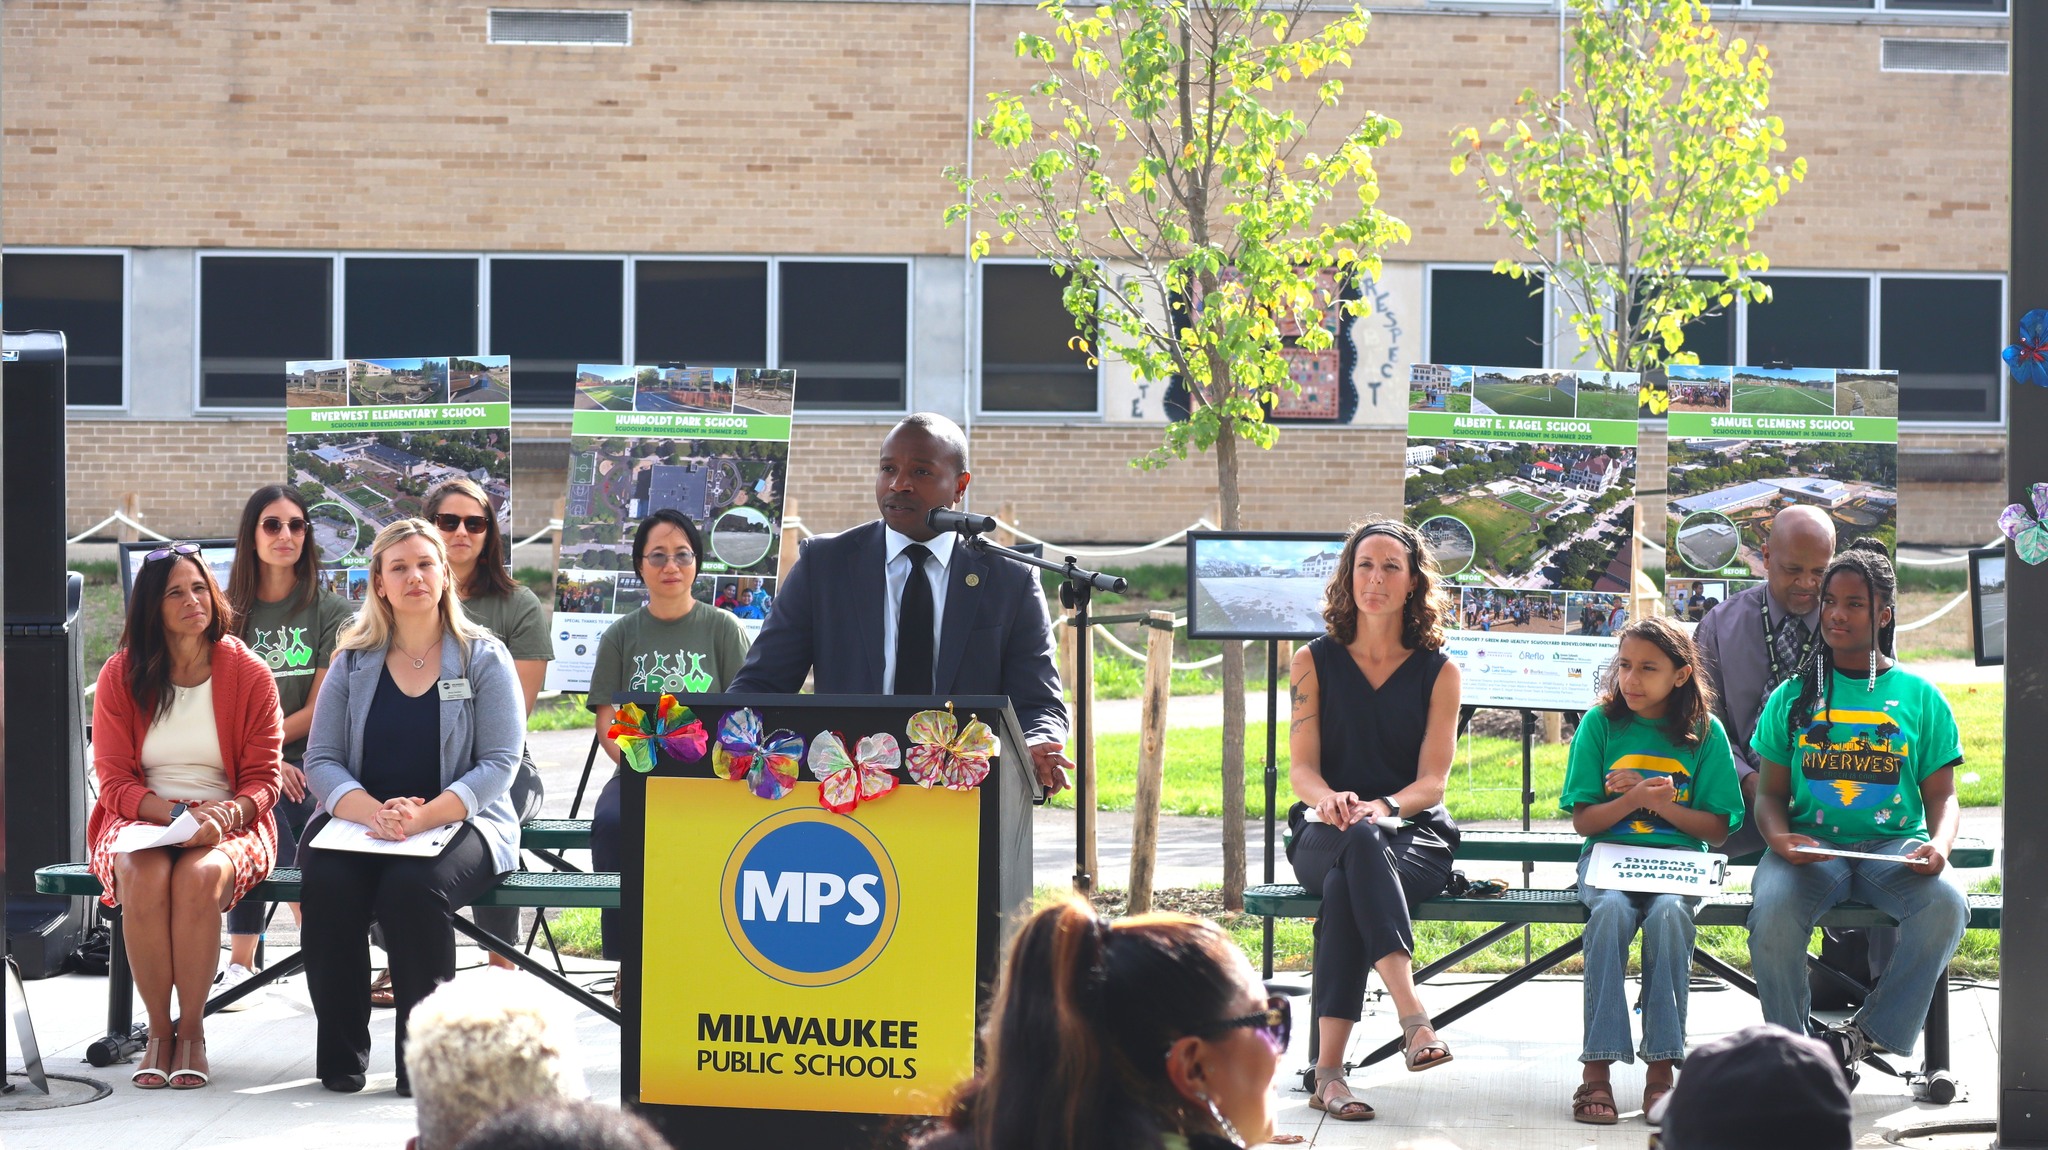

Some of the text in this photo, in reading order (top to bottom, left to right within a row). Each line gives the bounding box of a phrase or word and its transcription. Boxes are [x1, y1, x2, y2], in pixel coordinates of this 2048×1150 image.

[311, 406, 486, 422] RIVERWEST ELEMENTARY SCHOOL
[616, 414, 748, 428] HUMBOLDT PARK SCHOOL
[1454, 417, 1591, 433] ALBERT E. KAGEL SCHOOL
[1711, 417, 1855, 431] SAMUEL CLEMENS SCHOOL
[1493, 430, 1541, 438] REDEVELOPMENT
[1753, 429, 1801, 437] REDEVELOPMENT
[1525, 651, 1544, 661] Reflo
[1802, 751, 1900, 773] RIVERWEST
[1612, 862, 1706, 875] Elementary
[1624, 857, 1696, 867] Students
[1618, 872, 1698, 884] Riverwest
[742, 870, 880, 926] MPS
[698, 1013, 918, 1050] MILWAUKEE
[697, 1050, 918, 1080] PUBLIC SCHOOLS
